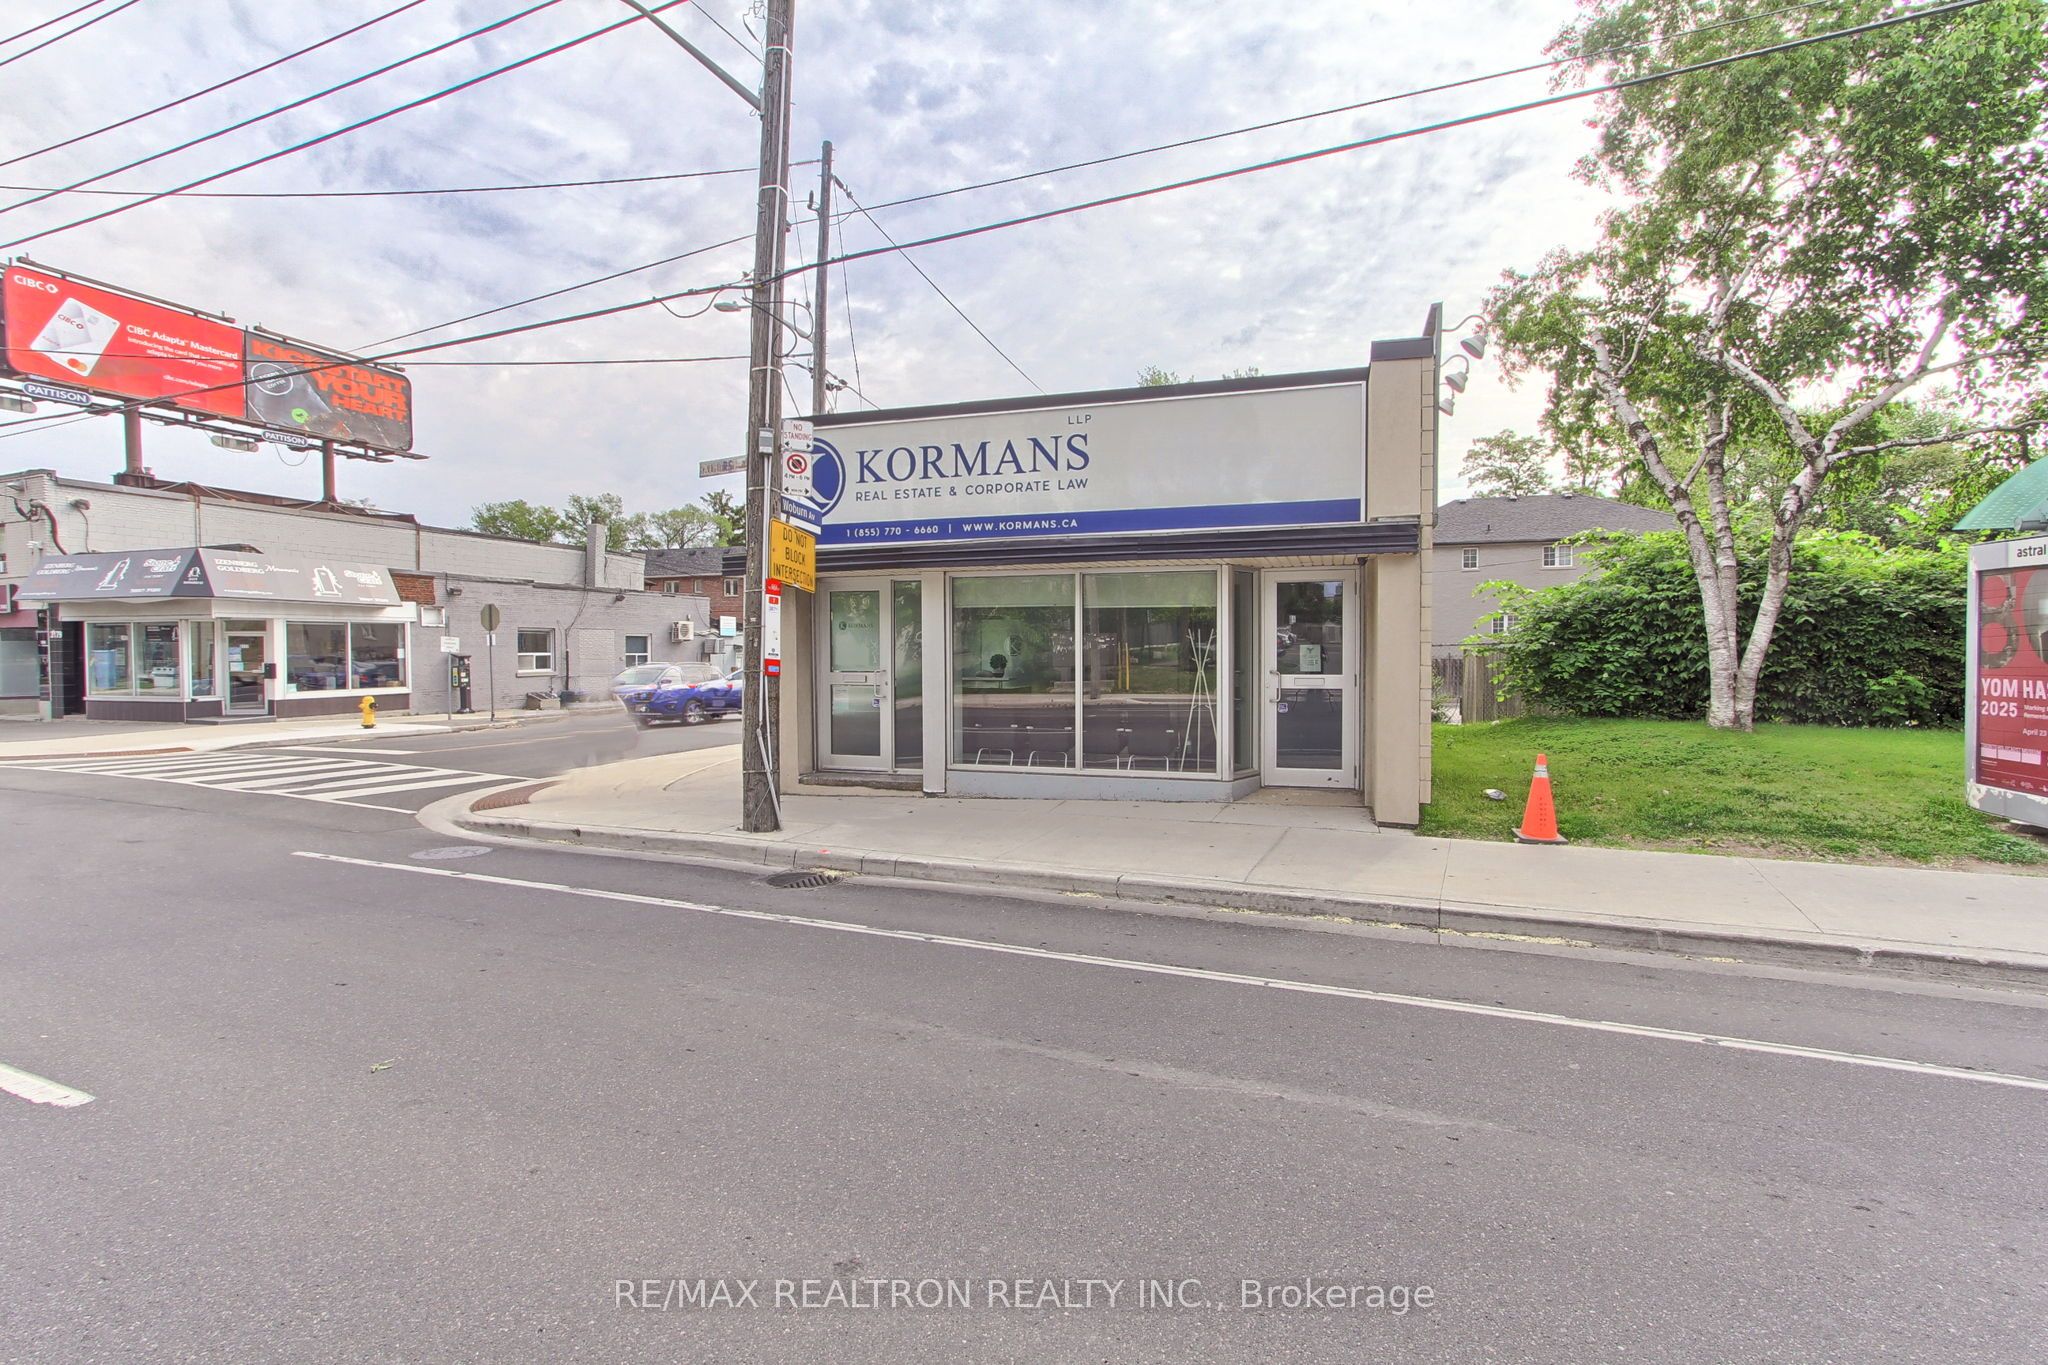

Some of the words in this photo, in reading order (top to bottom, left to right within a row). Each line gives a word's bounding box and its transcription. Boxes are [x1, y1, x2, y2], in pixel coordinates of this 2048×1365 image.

[13, 275, 46, 290] CIBC
[126, 325, 150, 337] CIBC
[190, 341, 238, 359] Mastercard
[28, 384, 88, 403] PATTISON
[310, 370, 407, 412] YOUR
[330, 394, 407, 423] HEART
[793, 423, 803, 432] NO
[1068, 414, 1092, 425] LLP
[264, 431, 306, 446] PATTISON
[784, 432, 812, 441] STANDING
[856, 433, 1090, 484] KORMANS
[856, 490, 888, 501] REAL
[894, 487, 942, 500] ESTATE
[949, 486, 957, 497] &
[965, 480, 1051, 495] CORPORATE
[1058, 478, 1088, 491] LAW
[783, 499, 808, 518] Woburn
[808, 513, 816, 521] Av
[854, 527, 880, 537] (855)
[884, 526, 902, 536] 770
[914, 525, 939, 535] 6660
[963, 518, 1078, 532] WWW.KORMANS.CA
[783, 527, 792, 543] DO
[794, 530, 807, 549] NOT
[785, 546, 806, 566] BLOCK
[2016, 543, 2046, 558] astral
[773, 562, 814, 588] INTERSECTION
[1981, 677, 2018, 698] YOM
[2022, 679, 2048, 700] HA
[1981, 700, 2018, 718] 2025
[2022, 728, 2039, 737] April
